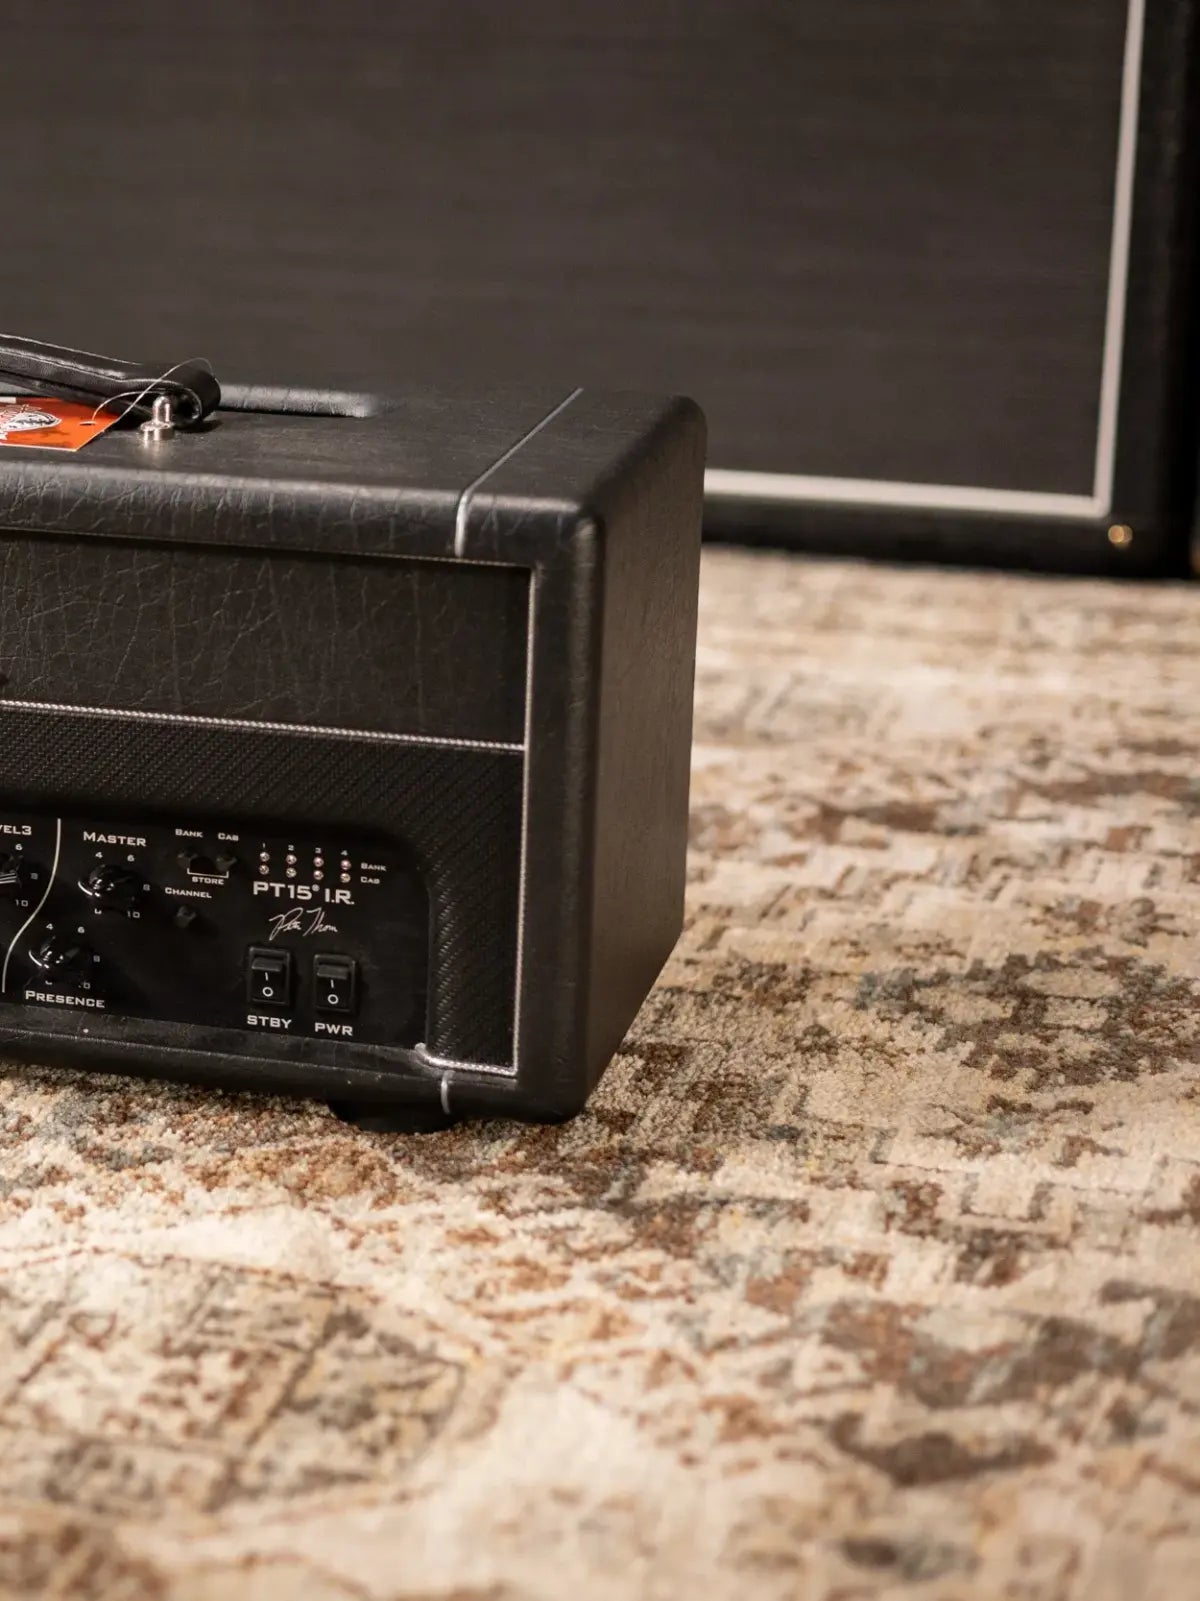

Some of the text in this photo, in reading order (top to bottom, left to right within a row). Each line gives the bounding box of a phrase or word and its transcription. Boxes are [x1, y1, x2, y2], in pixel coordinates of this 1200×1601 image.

[175, 828, 203, 838] BANK
[218, 832, 239, 842] CAB
[83, 831, 146, 847] MASTER
[361, 862, 386, 871] BANK
[192, 876, 224, 885] STORE
[360, 876, 380, 884] CAB
[165, 887, 212, 899] CHANNEL
[25, 990, 105, 1009] PRESENCE
[247, 1015, 292, 1029] STBY
[314, 1022, 353, 1036] PWR
